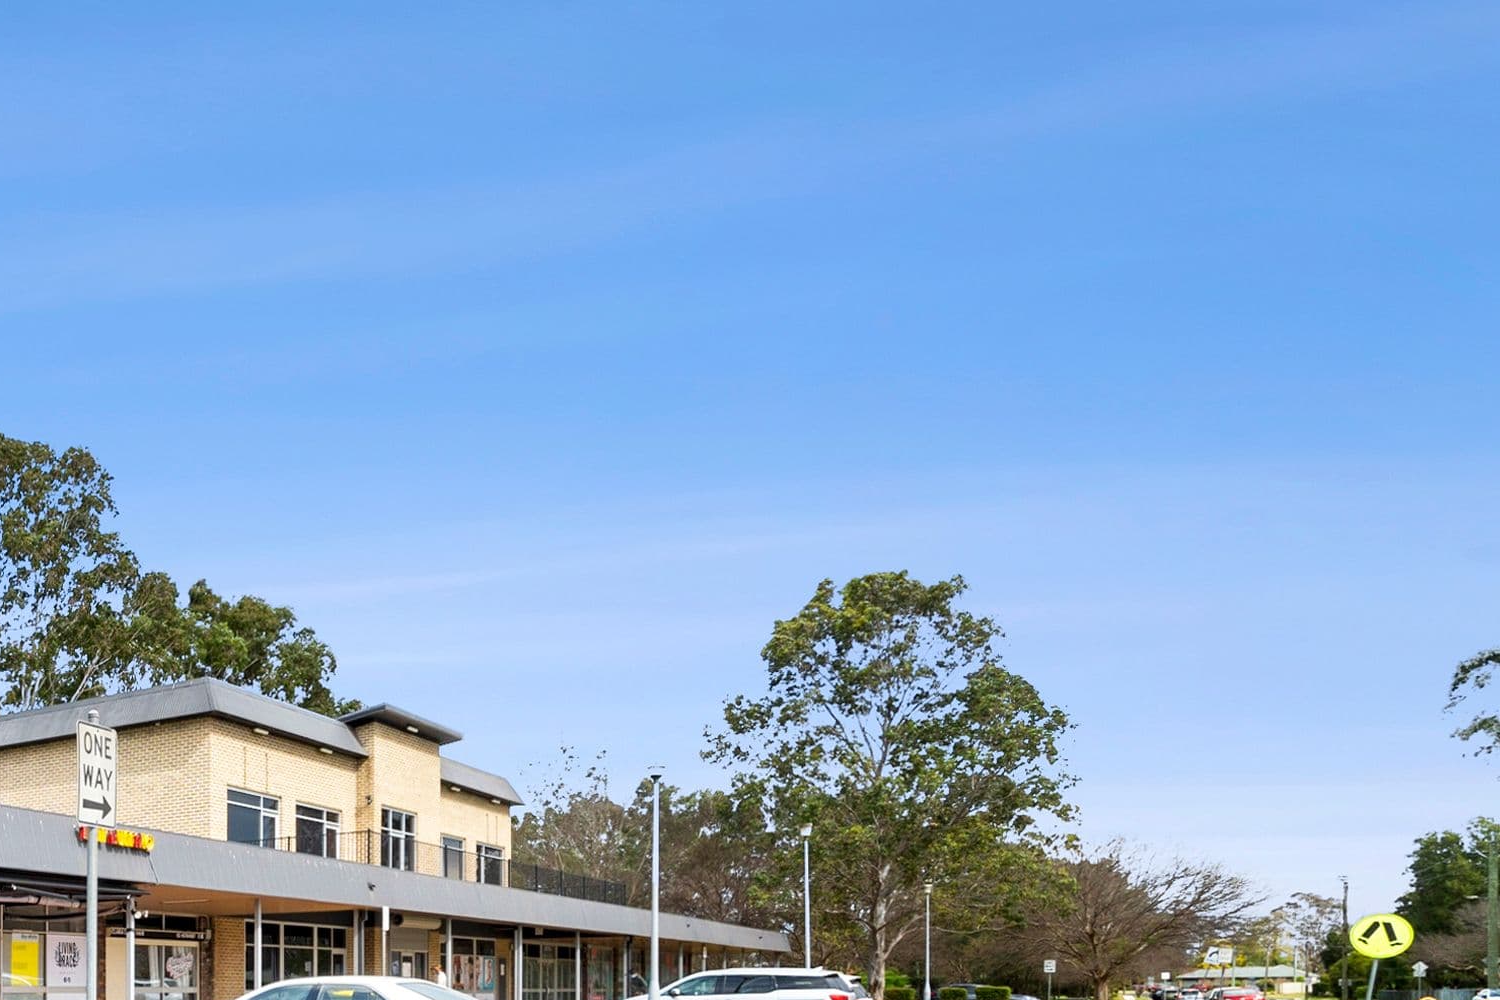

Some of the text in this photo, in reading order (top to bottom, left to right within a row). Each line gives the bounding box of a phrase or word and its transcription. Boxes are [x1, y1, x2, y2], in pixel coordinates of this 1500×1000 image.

[83, 731, 112, 760] ONE
[82, 763, 113, 791] WAY
[58, 941, 77, 955] LIVING
